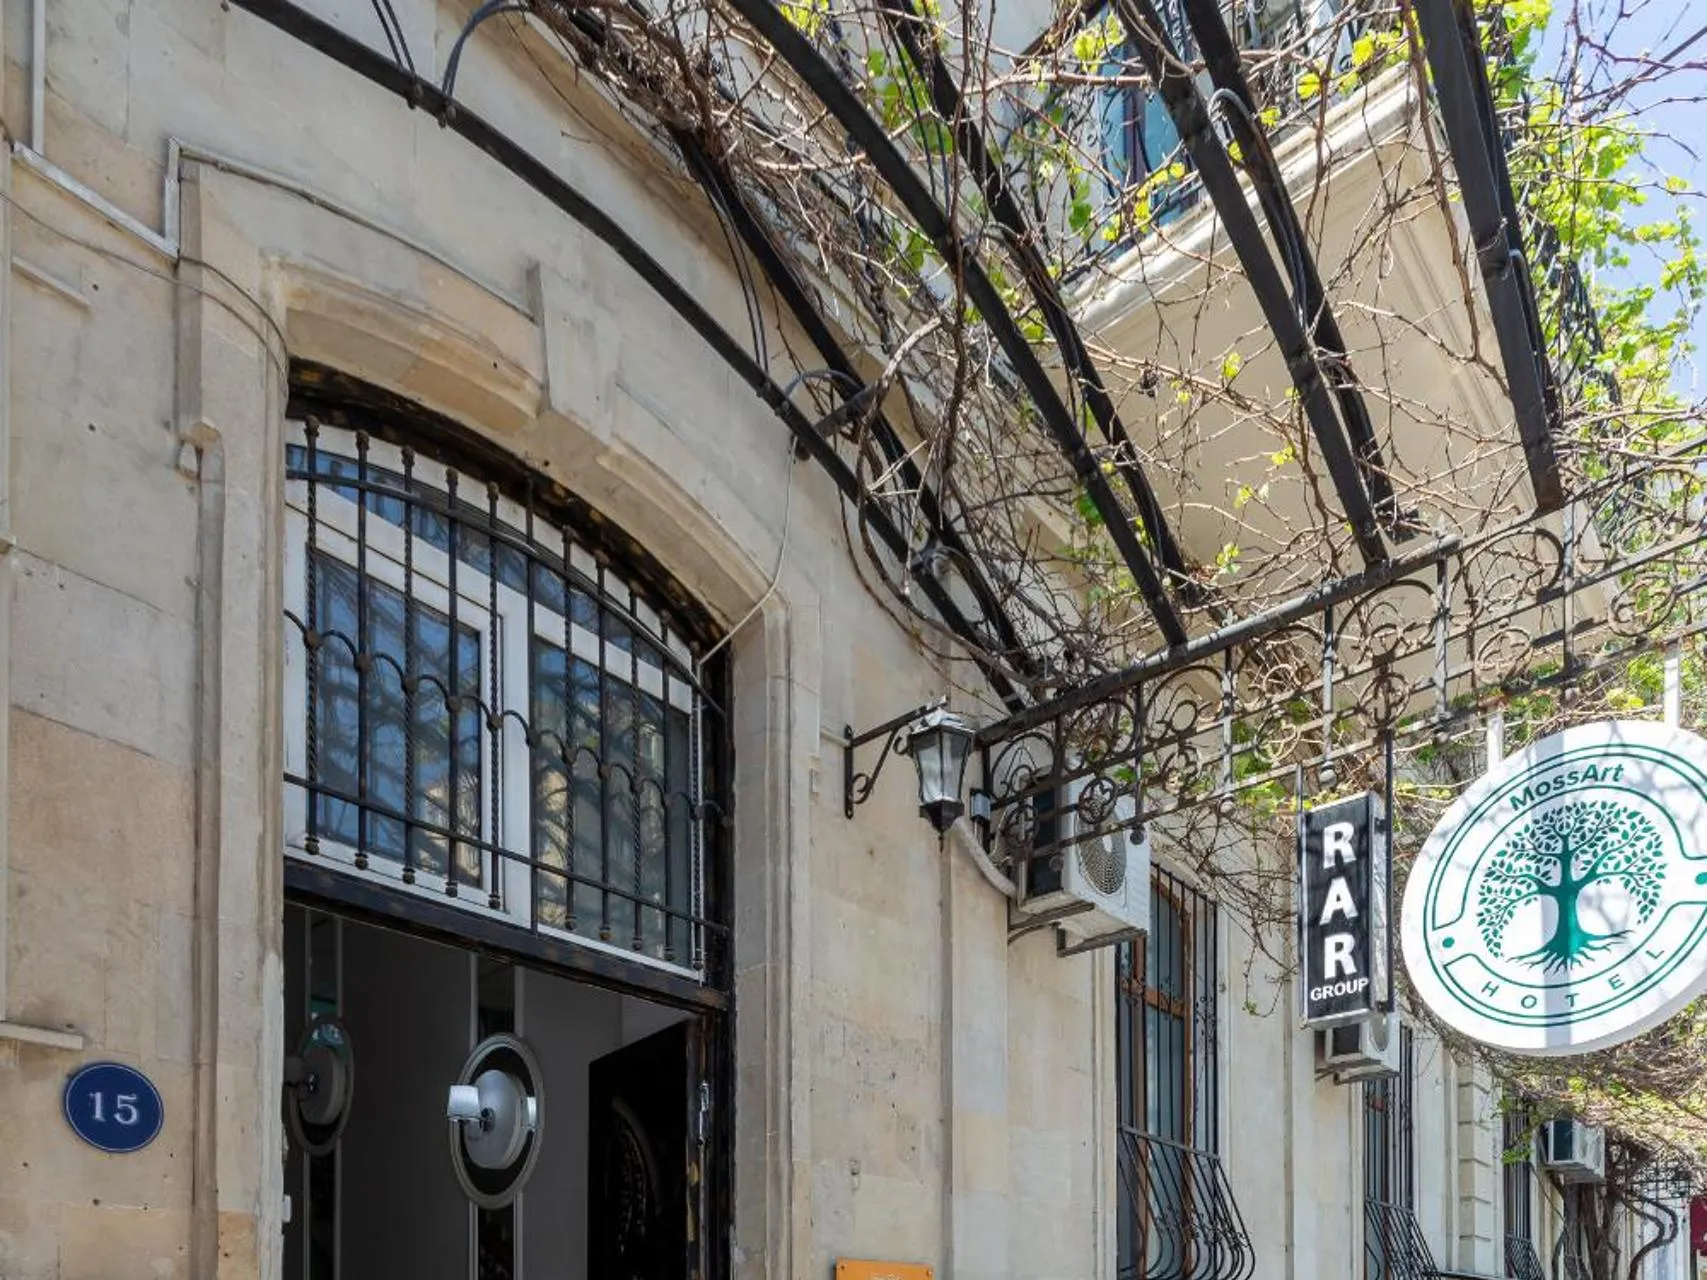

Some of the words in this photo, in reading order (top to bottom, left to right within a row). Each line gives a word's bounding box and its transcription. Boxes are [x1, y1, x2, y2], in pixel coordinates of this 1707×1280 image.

[1509, 764, 1624, 811] MossArt
[1319, 821, 1358, 980] RAR
[1310, 977, 1370, 1001] GROUP
[1481, 948, 1665, 1010] HOTEL
[88, 1091, 138, 1125] 15
